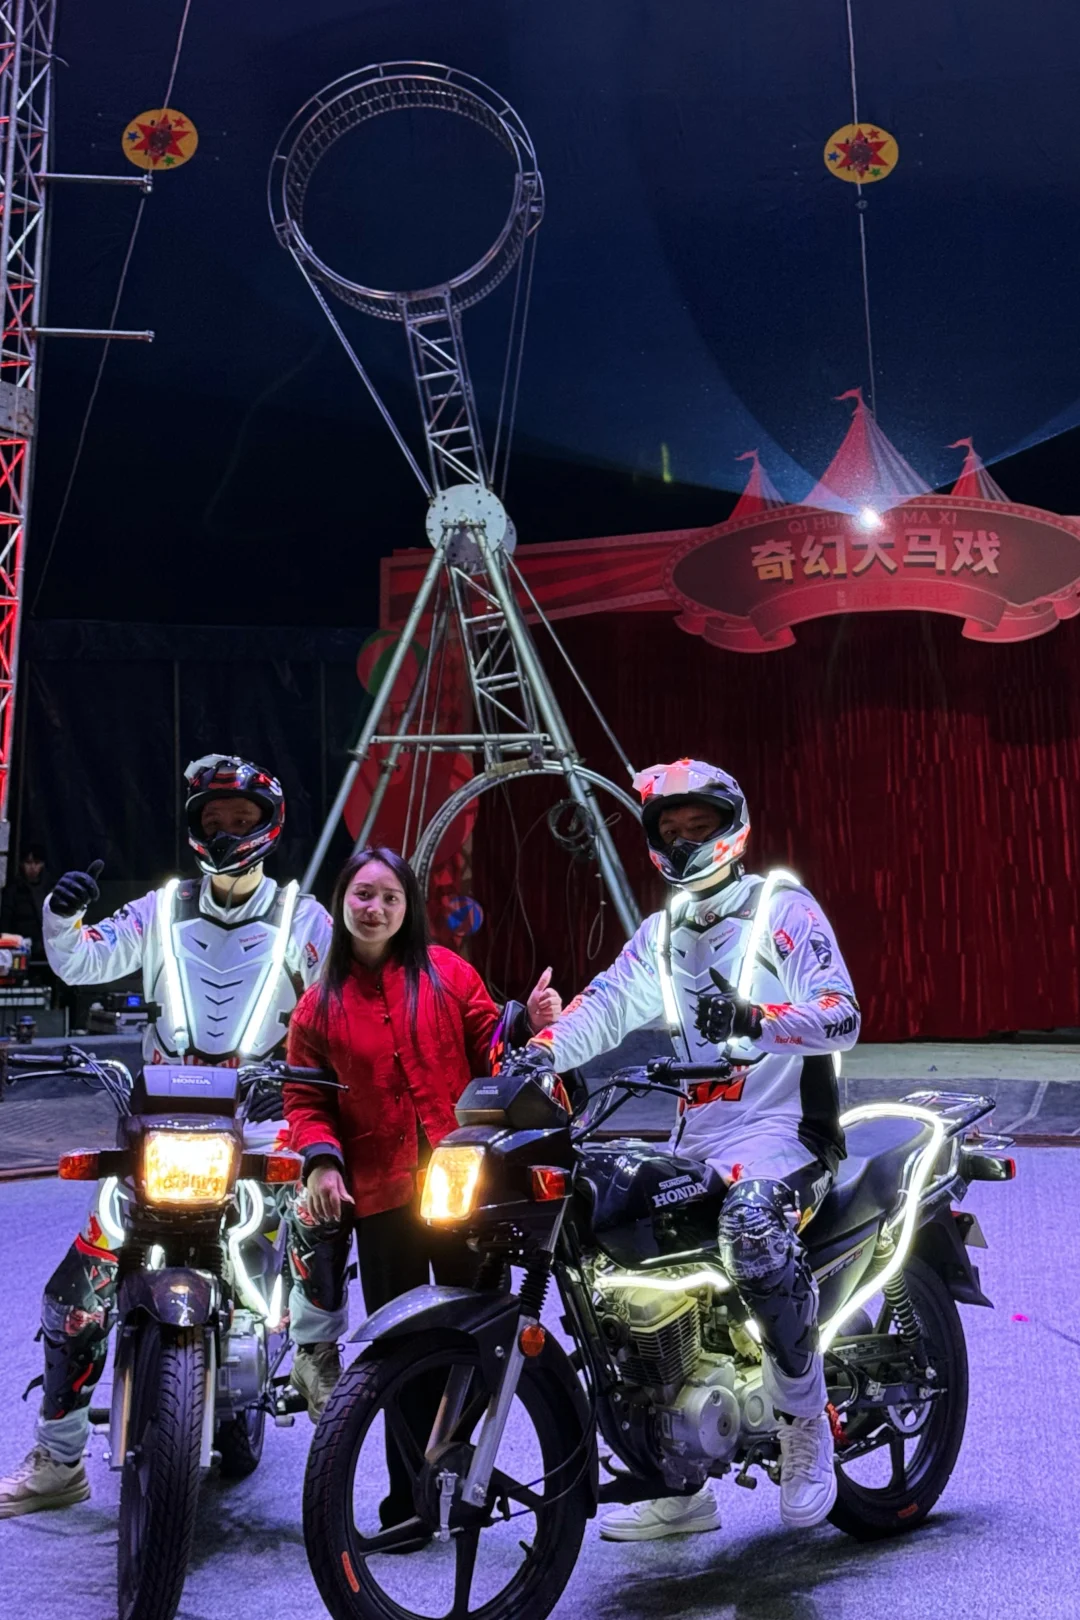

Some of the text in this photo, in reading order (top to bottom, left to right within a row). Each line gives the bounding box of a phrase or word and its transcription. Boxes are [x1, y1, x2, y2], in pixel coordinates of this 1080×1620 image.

[789, 520, 807, 534] QI
[903, 511, 931, 524] MA
[939, 511, 957, 525] XI
[752, 528, 1000, 581] 奇幻大马戏
[652, 1182, 708, 1208] HONDA
